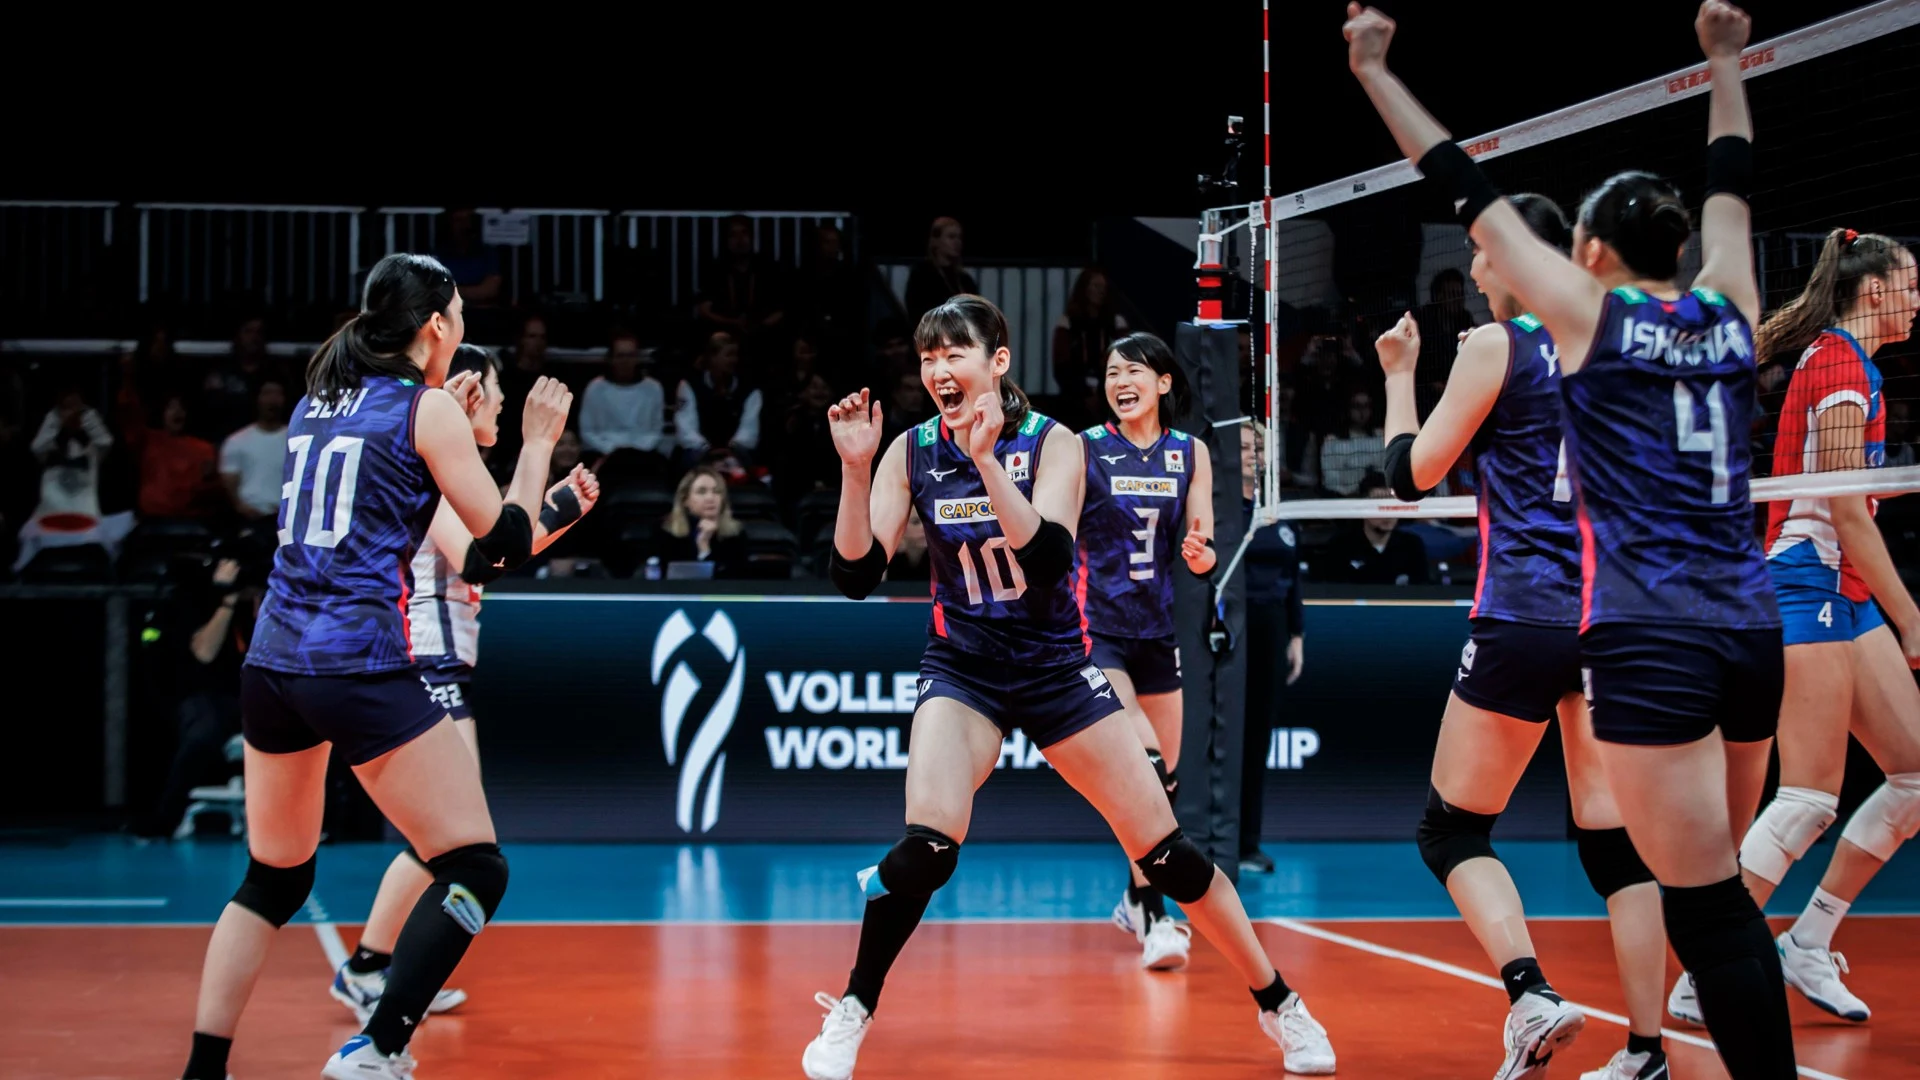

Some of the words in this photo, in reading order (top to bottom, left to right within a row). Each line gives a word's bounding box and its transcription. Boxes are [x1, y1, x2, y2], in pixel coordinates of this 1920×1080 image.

[1673, 380, 1730, 504] 4
[277, 435, 365, 548] 30
[1115, 480, 1172, 493] CAPCOM
[940, 501, 996, 519] CAPC
[1130, 507, 1160, 564] 3
[958, 537, 1027, 605] 10
[1818, 601, 1833, 628] 4
[765, 671, 920, 714] VOLLE
[764, 726, 909, 769] WORL
